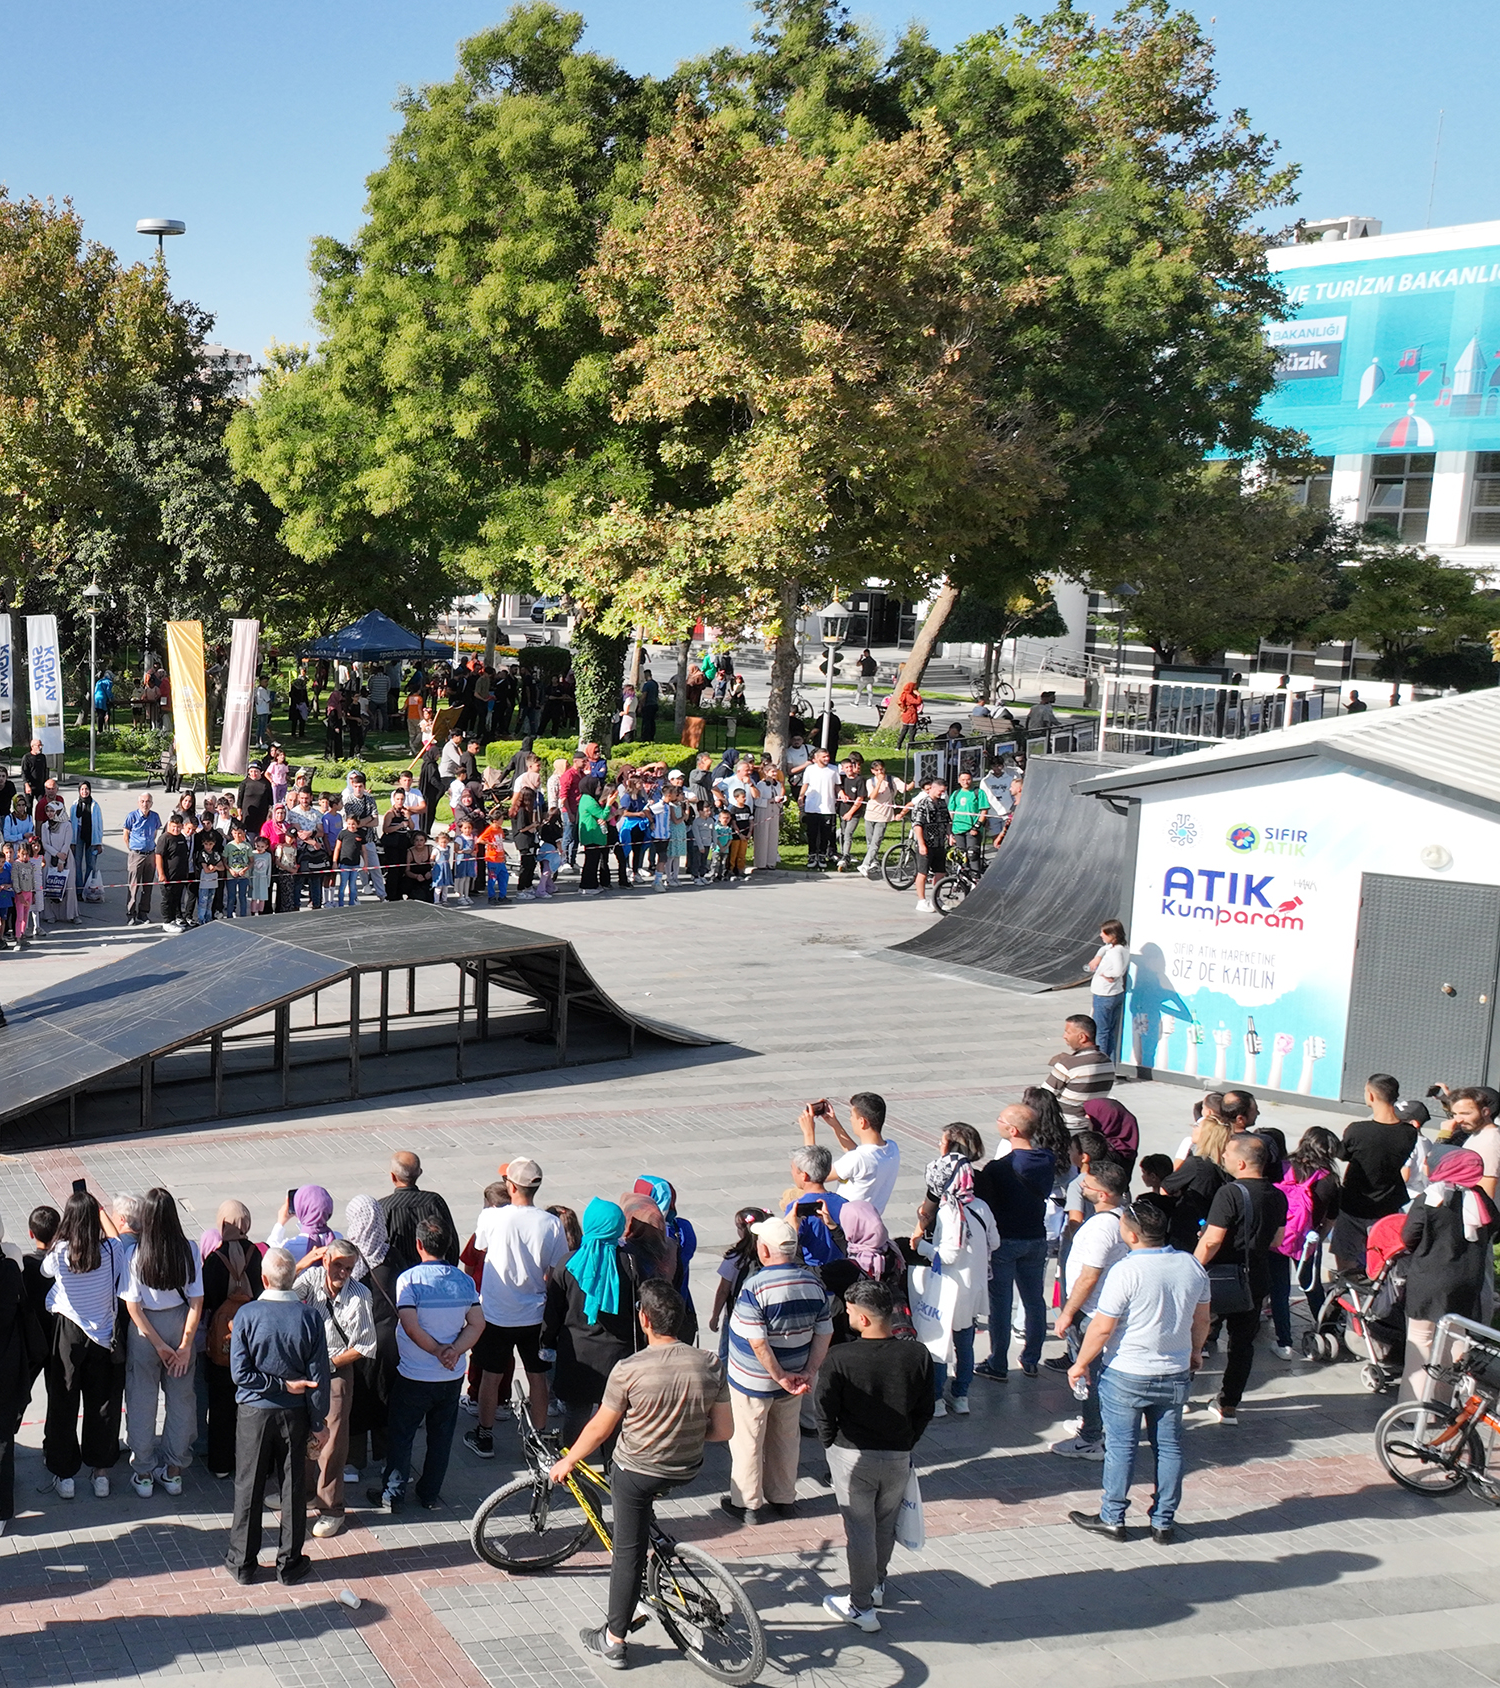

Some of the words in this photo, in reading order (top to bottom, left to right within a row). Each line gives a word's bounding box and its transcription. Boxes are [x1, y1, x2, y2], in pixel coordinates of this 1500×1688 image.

[1316, 275, 1396, 301] TURİZM
[1273, 322, 1340, 341] BAKANLIĞI
[1265, 827, 1308, 843] SIFIR
[1264, 841, 1307, 857] ATIK
[1163, 866, 1275, 908] ATIK
[1173, 942, 1194, 956] SIFIR
[1198, 945, 1217, 960] ATIK
[1172, 956, 1193, 980] SİZ
[1198, 961, 1217, 984] DE
[1222, 965, 1276, 990] KATILIN
